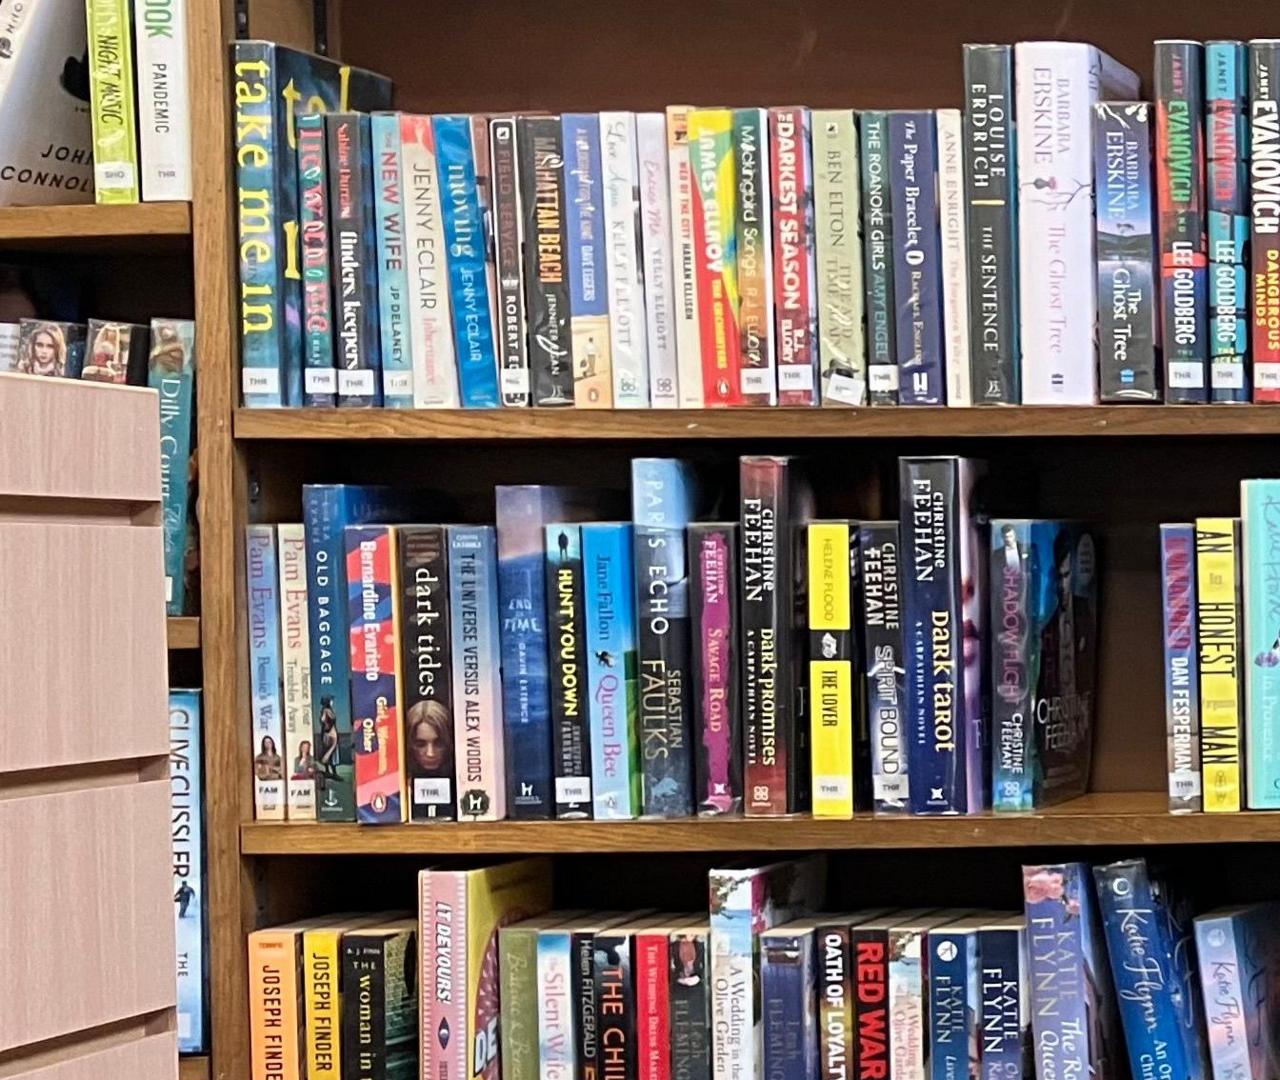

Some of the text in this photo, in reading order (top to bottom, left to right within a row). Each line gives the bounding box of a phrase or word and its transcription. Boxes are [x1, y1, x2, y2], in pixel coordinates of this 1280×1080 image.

[151, 62, 170, 134] PANDEMIC
[972, 84, 989, 187] ERDRICH
[989, 94, 1004, 177] LOUISE
[234, 59, 272, 335] take me in
[381, 152, 401, 270] NEW WIFE
[772, 121, 800, 309] DARKEST SEASON
[868, 122, 885, 270] THE ROANOKE GIRLS
[1252, 99, 1279, 234] EVANOVICH
[413, 163, 437, 310] JENNY ECLAIR
[1173, 241, 1195, 344] LEE GOLDBERG
[1255, 274, 1266, 327] MINDS
[1267, 249, 1279, 351] DANGEROUS
[316, 551, 327, 586] OLD
[913, 479, 933, 582] FEEHAN
[933, 492, 945, 568] CHRISTINE
[318, 594, 332, 684] BAGGAGE
[415, 567, 442, 697] dark tides
[558, 569, 579, 717] HUNT YOU DOWN
[1197, 530, 1238, 764] AN HONEST MAN
[822, 671, 837, 727] THE LOVER
[263, 966, 281, 1029] JOSEPH
[602, 967, 623, 1015] THE
[824, 934, 841, 979] OATH
[824, 983, 842, 1007] OF
[857, 941, 886, 1080] RED WAR
